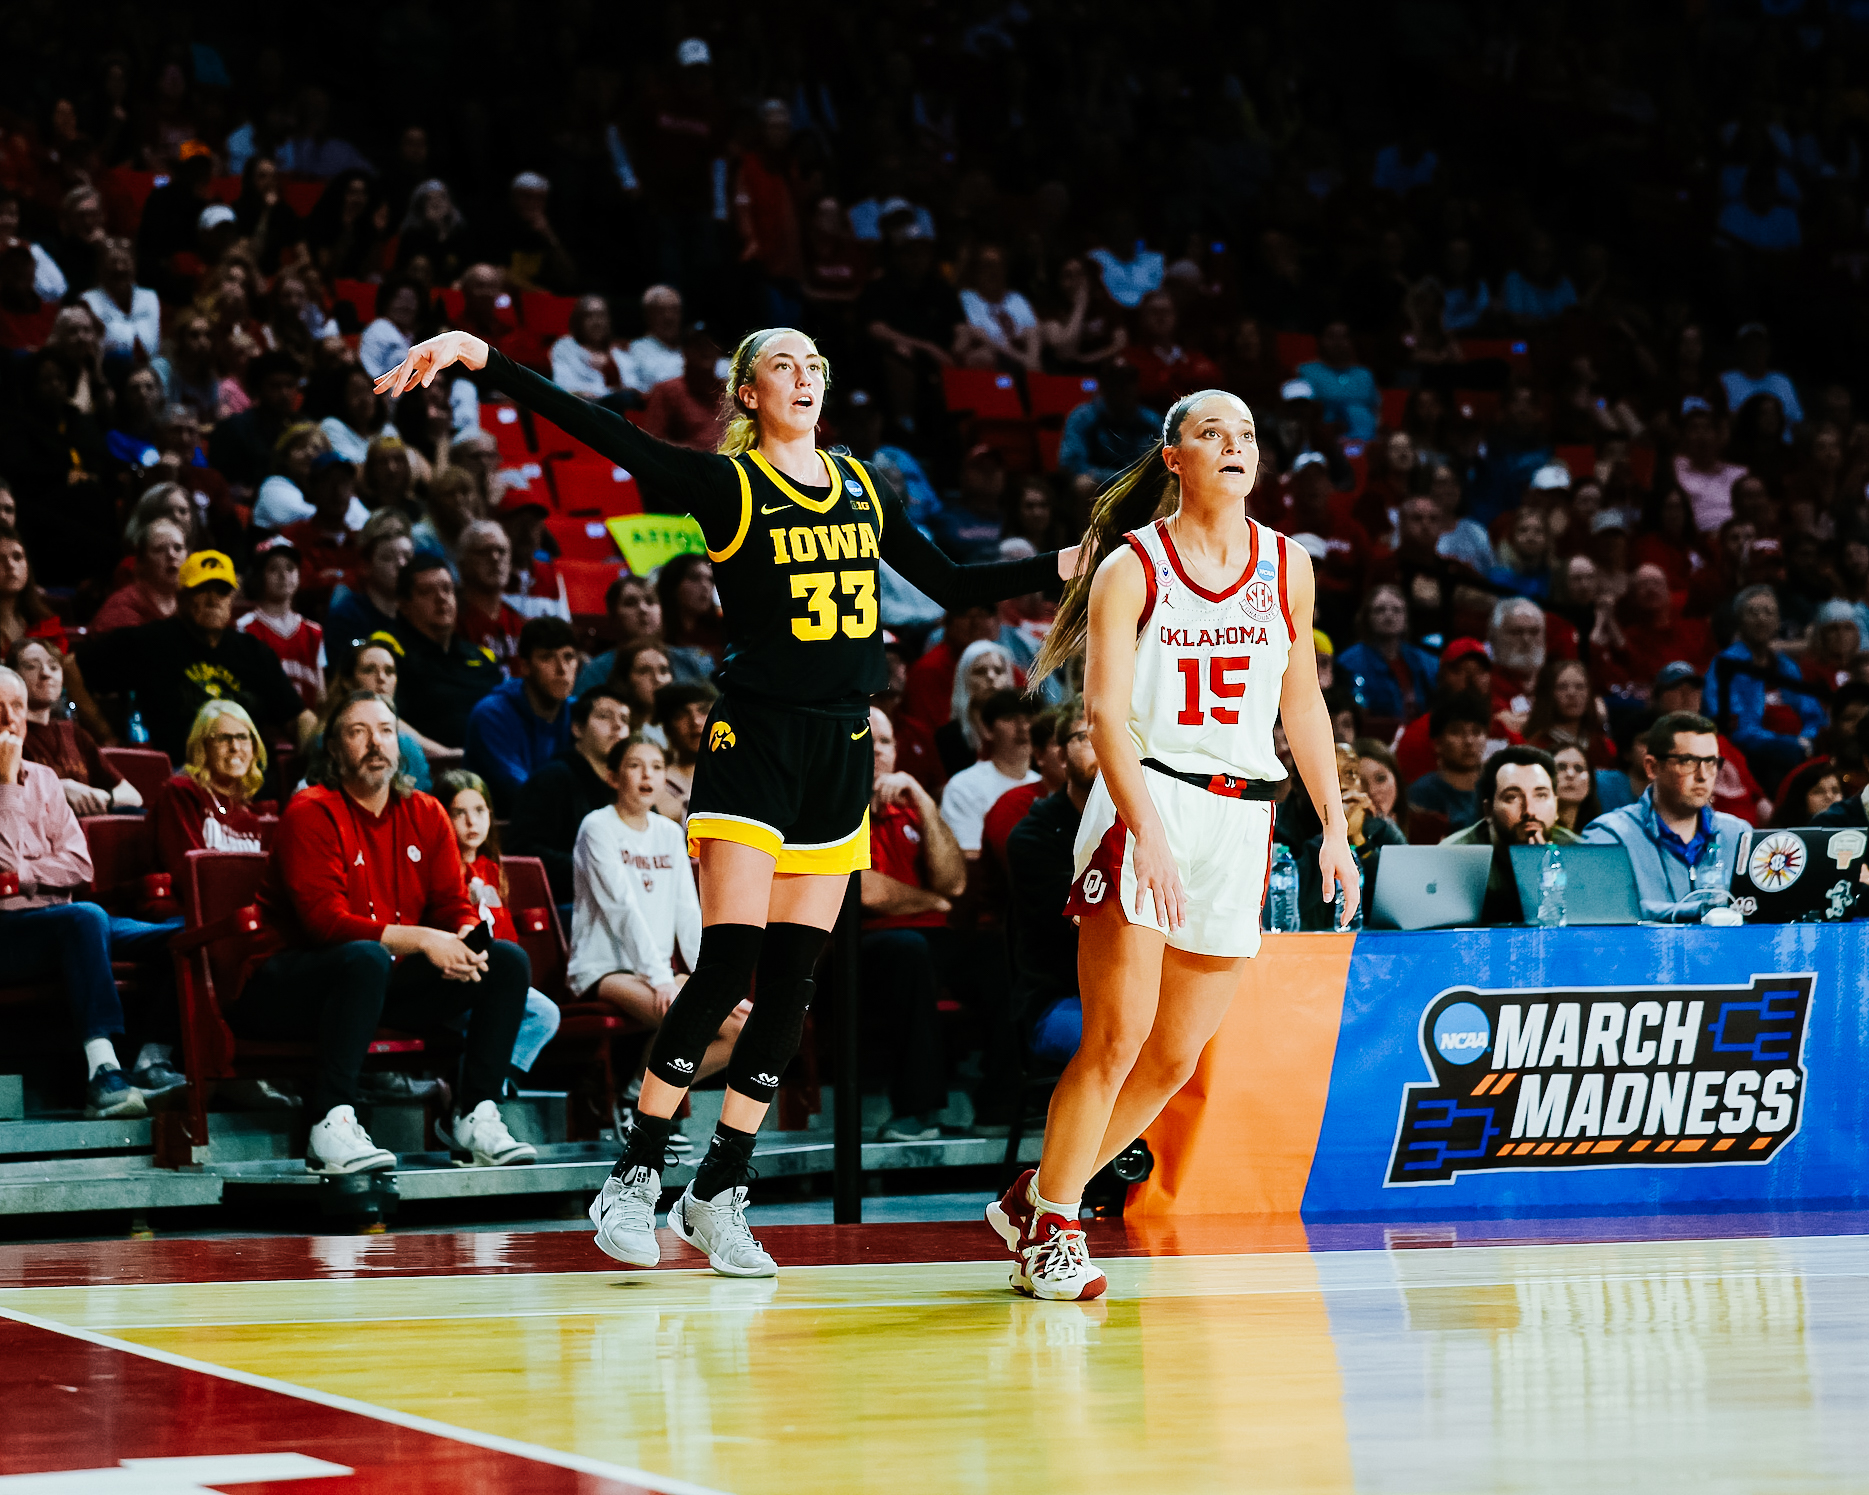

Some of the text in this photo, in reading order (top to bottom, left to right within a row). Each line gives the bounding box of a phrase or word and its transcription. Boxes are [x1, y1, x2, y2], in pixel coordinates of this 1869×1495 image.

[770, 522, 880, 564] IOWA
[789, 570, 878, 642] 33
[1246, 582, 1273, 612] SEC
[1177, 656, 1251, 725] 15
[1083, 869, 1107, 904] OU
[1440, 1032, 1488, 1049] NCAA
[1491, 1001, 1705, 1069] MARCH
[1510, 1069, 1798, 1138] MADNESS
